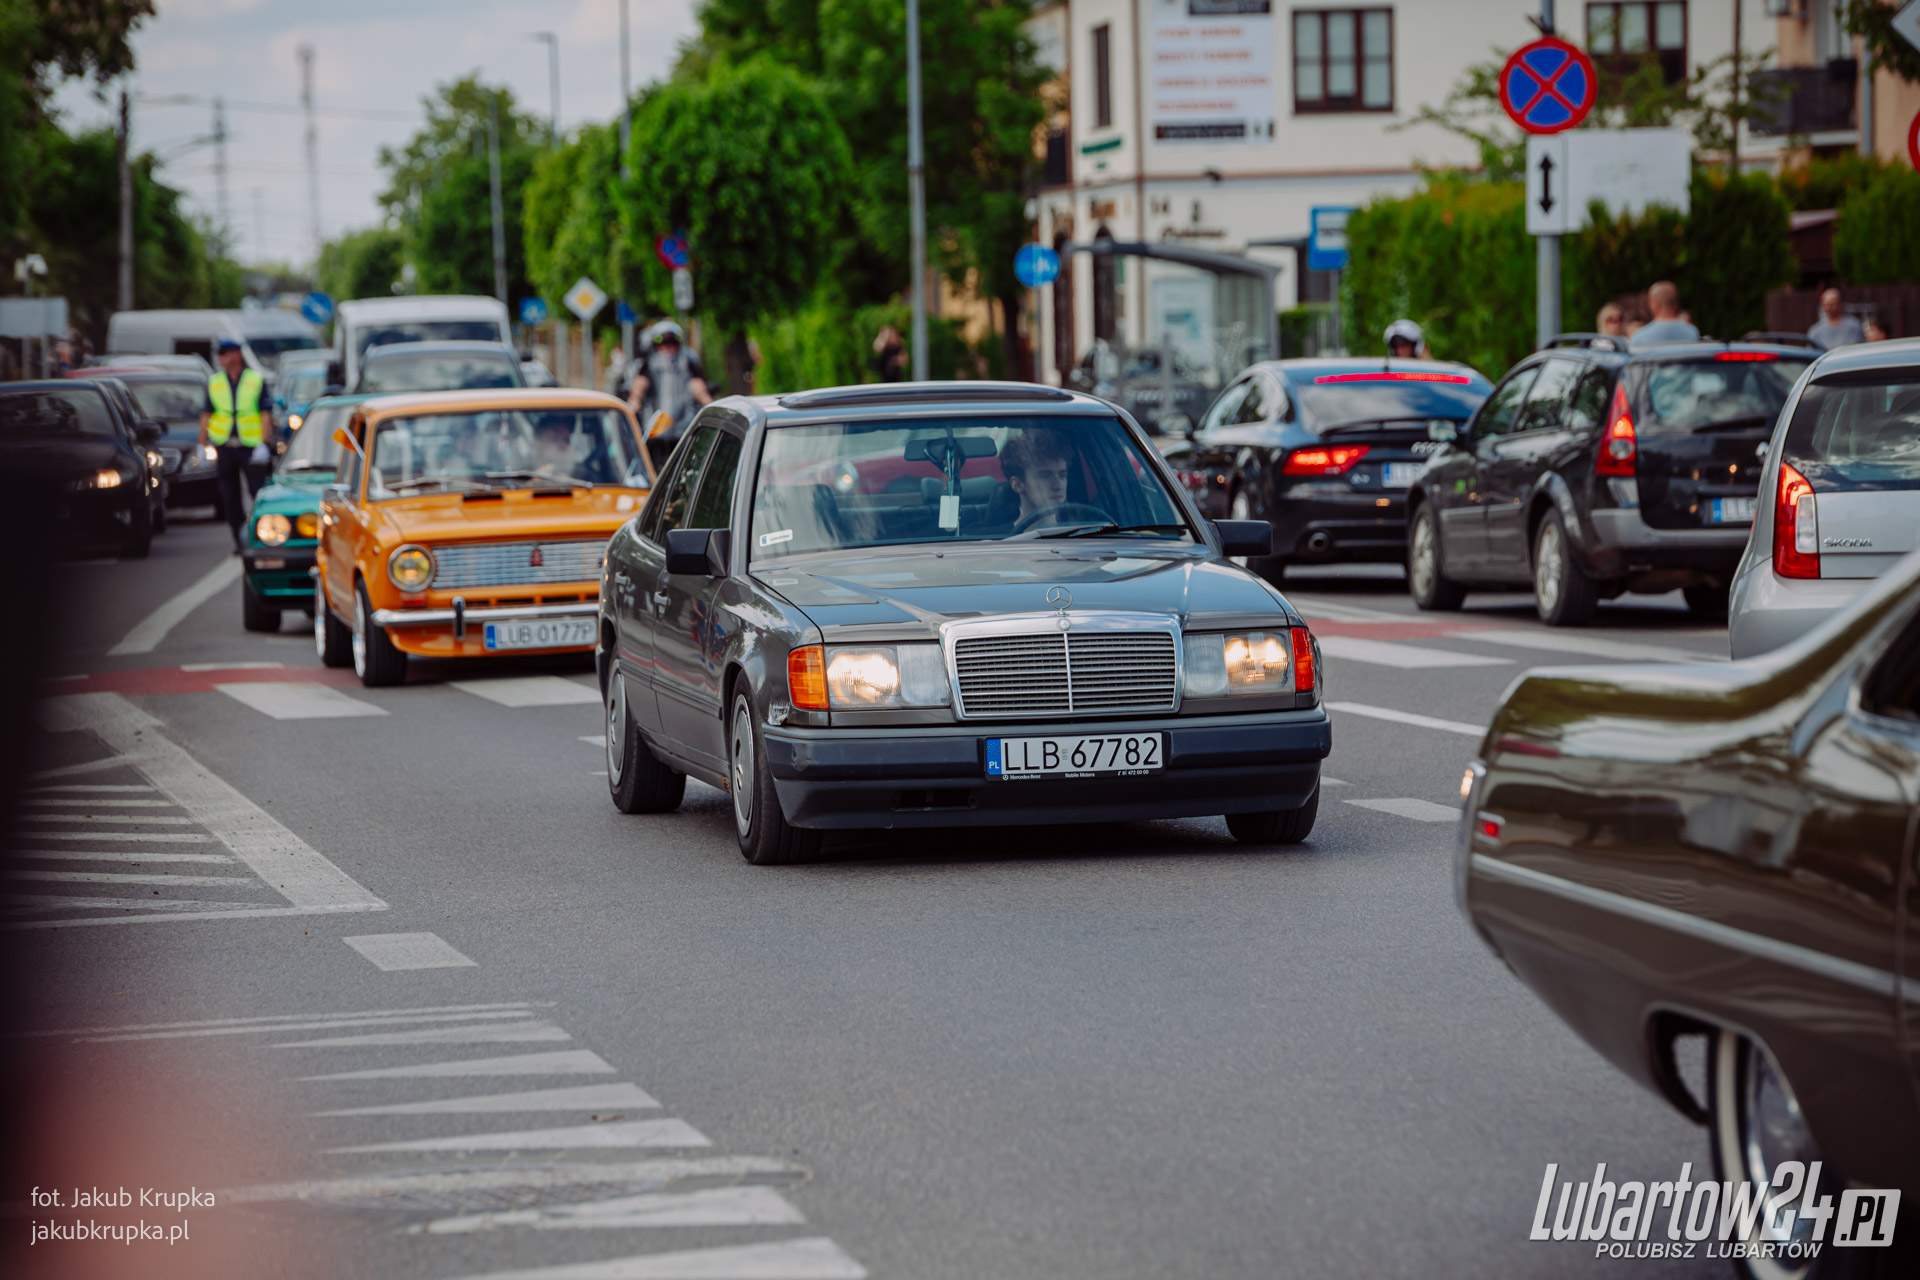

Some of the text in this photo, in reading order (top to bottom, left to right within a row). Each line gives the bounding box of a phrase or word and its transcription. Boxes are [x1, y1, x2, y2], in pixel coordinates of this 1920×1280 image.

[537, 622, 593, 642] 0177P
[1004, 736, 1159, 771] LLB 67782
[989, 761, 1000, 769] PL
